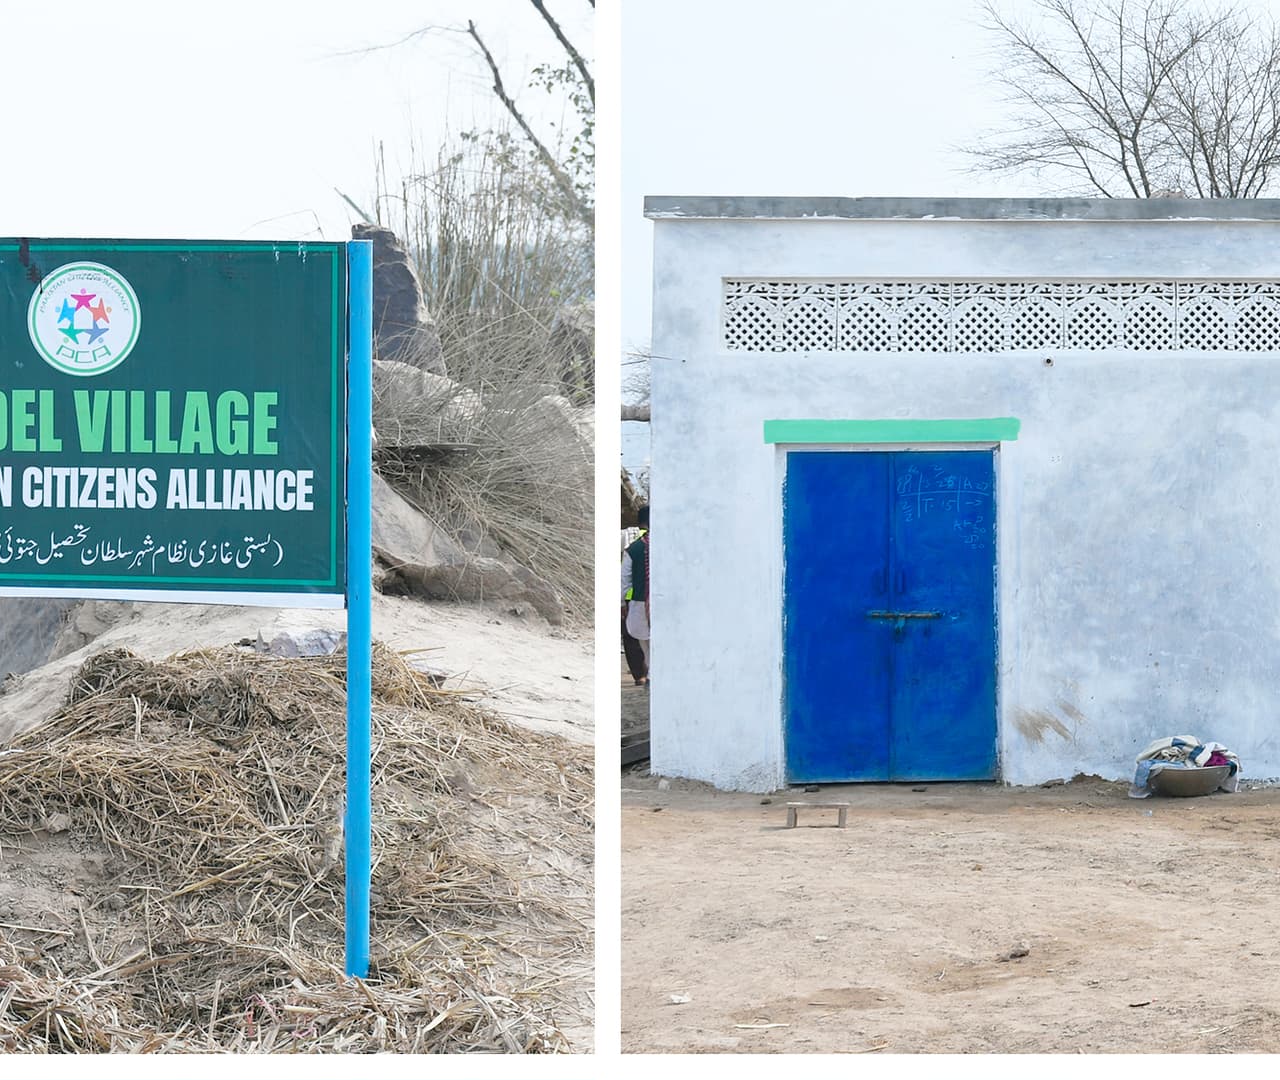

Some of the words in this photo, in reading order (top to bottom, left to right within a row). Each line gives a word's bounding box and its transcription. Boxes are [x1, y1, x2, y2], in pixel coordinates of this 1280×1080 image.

[56, 344, 111, 363] PCA
[73, 389, 279, 456] VILLAGE
[22, 466, 157, 509] CITIZENS
[167, 468, 314, 511] ALLIANCE
[36, 523, 91, 565] تحصیل
[81, 538, 133, 565] سلطان
[128, 534, 155, 569] شہر
[152, 539, 187, 574] نظام
[188, 539, 233, 568] غازی
